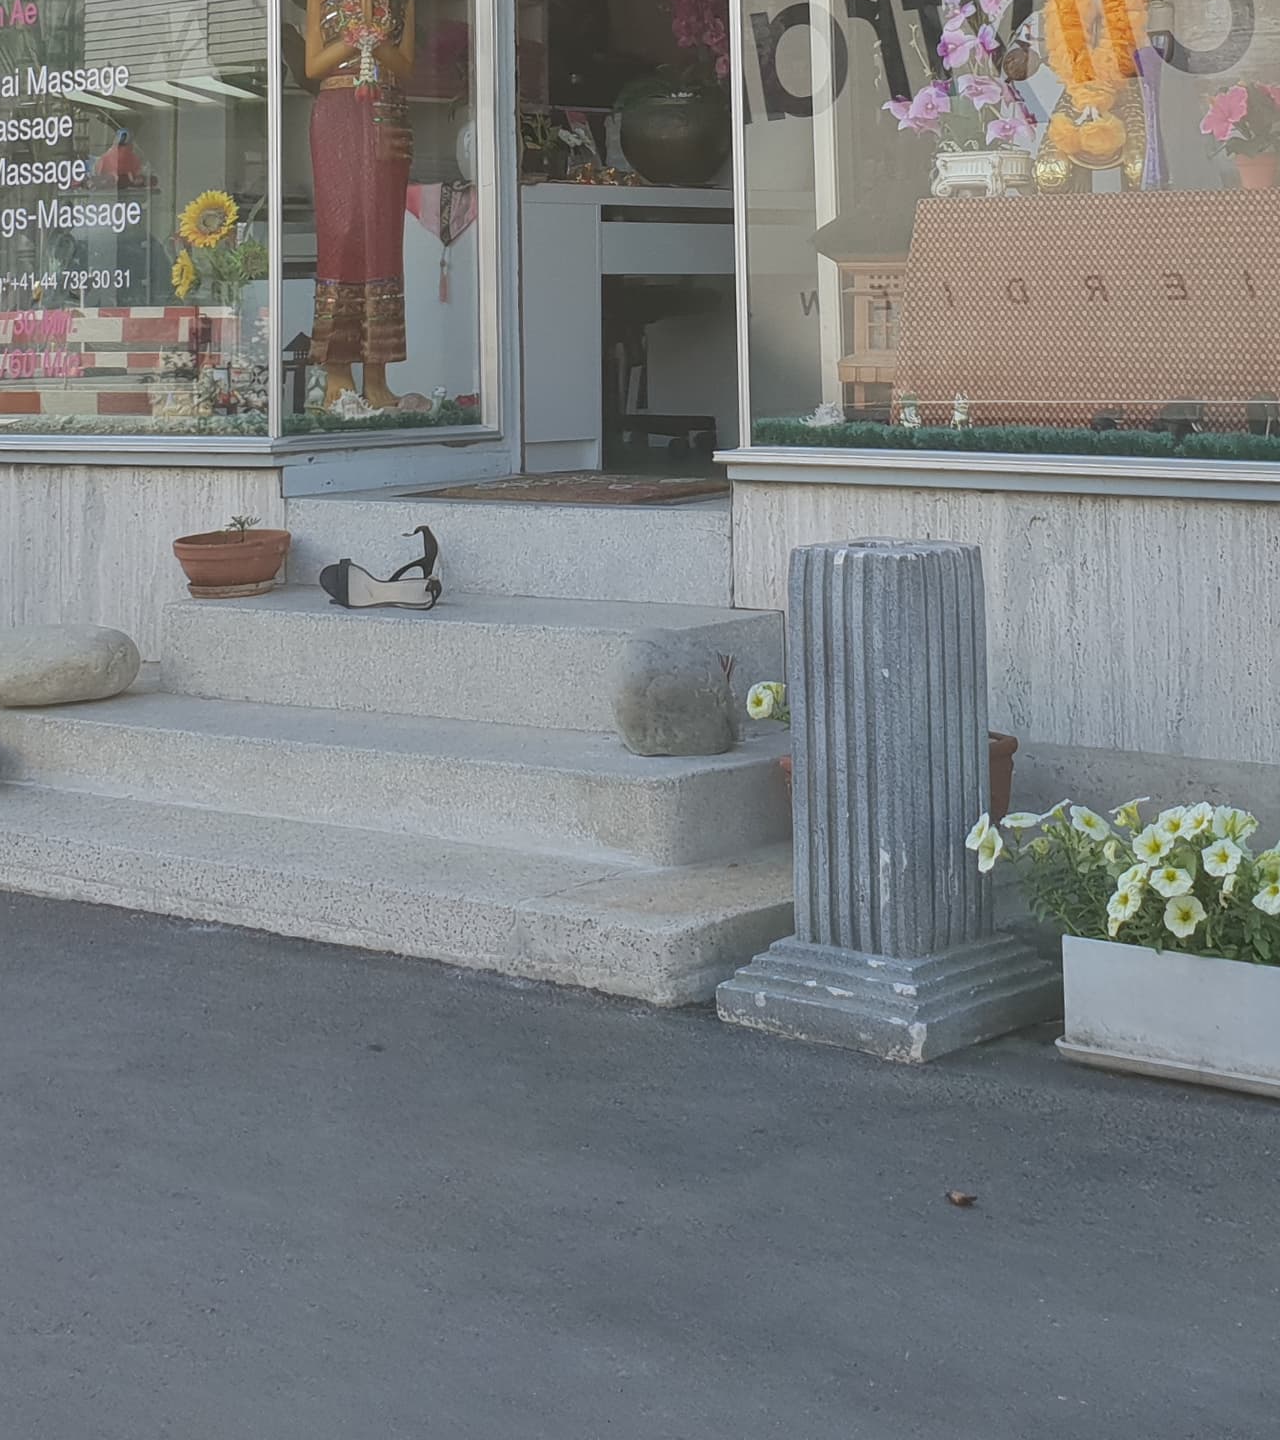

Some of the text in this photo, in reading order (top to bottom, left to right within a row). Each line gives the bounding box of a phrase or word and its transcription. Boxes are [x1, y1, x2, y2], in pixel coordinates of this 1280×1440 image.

[27, 64, 129, 96] Massage
[10, 272, 35, 291] +41
[40, 271, 58, 290] 44
[63, 270, 88, 290] 732
[92, 269, 109, 289] 30
[114, 268, 131, 288] 31
